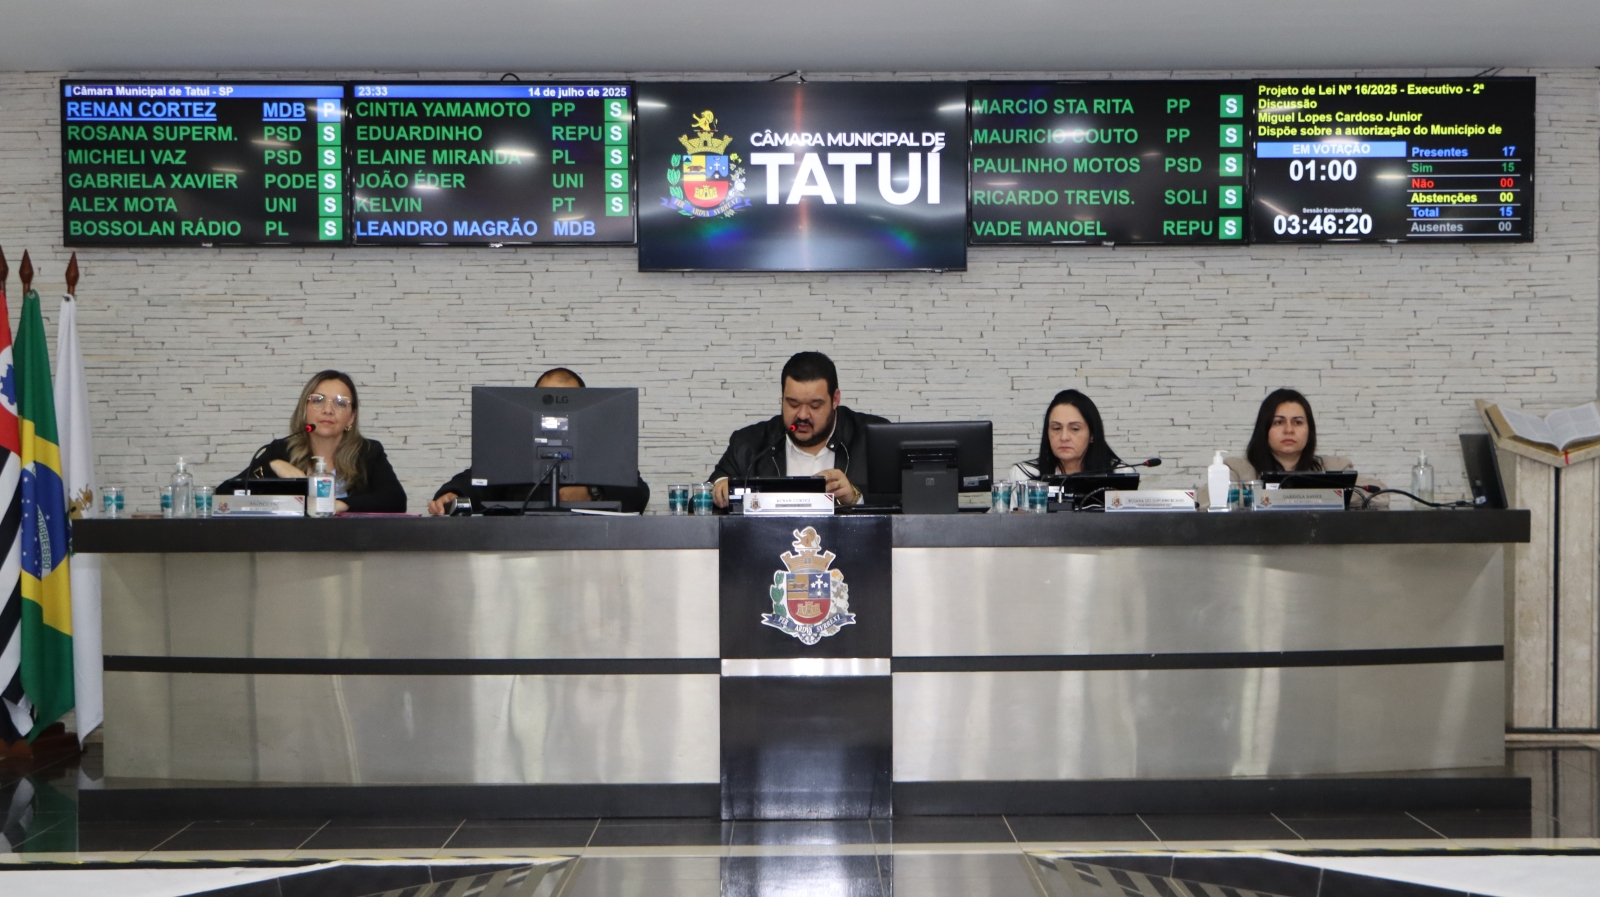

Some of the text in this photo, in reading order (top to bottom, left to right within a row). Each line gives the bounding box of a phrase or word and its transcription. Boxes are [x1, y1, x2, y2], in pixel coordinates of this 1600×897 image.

[73, 86, 113, 96] Câmara
[116, 86, 166, 98] Municipal
[169, 87, 182, 96] de
[219, 87, 234, 96] SP
[358, 87, 388, 96] 23:33
[529, 88, 627, 98] 14 de julho de 2025
[1258, 86, 1299, 98] Projeto
[1301, 86, 1315, 95] de
[1318, 85, 1335, 95] Lei
[1339, 85, 1352, 95] Nº
[1356, 85, 1397, 95] 16/2025
[1408, 84, 1463, 94] Executivo
[1473, 84, 1484, 94] 2ª
[67, 102, 335, 117] RENAN CORTEZ MDB P
[356, 102, 622, 117] CINTIA YAMAMOTO PP S
[974, 98, 1238, 114] MARCIO STA RITA PP S
[1258, 99, 1317, 109] Discussão
[1258, 112, 1422, 125] Miguel Lopes Cardoso Junior
[68, 126, 335, 141] ROSANA SUPERM. PSD S
[357, 126, 622, 141] EDUARDINHO REPU S
[750, 129, 946, 147] CÂMARA MUNICIPAL DE
[974, 128, 1238, 144] MAURICIO COUTO PP S
[1258, 126, 1297, 138] Dispõe
[1300, 126, 1332, 136] sobre
[1345, 125, 1410, 138] autorização
[1413, 125, 1428, 135] do
[1431, 125, 1485, 138] Município
[1488, 125, 1502, 135] de
[1293, 142, 1370, 156] EM VOTAÇÃO
[1412, 147, 1515, 157] Presentes 17
[68, 150, 336, 165] MICHELI VAZ PSD S
[357, 150, 622, 165] ELAINE MIRANDA PL S
[974, 157, 1237, 173] PAULINHO MOTOS PSD S
[750, 145, 945, 205] TATUÍ
[1289, 160, 1357, 181] 01:00
[1412, 163, 1515, 173] Sim 15
[68, 173, 336, 189] GABRIELA XAVIER PODE S
[356, 170, 622, 189] JOÃO ÉDER UNI S
[1411, 178, 1514, 188] Não 00
[69, 197, 336, 212] ALEX MOTA UNI S
[356, 198, 623, 212] KELVIN PT S
[974, 190, 1236, 205] RICARDO TREVIS. SOLI S
[1411, 193, 1513, 205] Abstenções 00
[1411, 208, 1513, 217] Total 15
[70, 217, 337, 236] BOSSOLAN RÁDIO PL S
[356, 217, 595, 236] LEANDRO MAGRÃO MDB
[973, 220, 1236, 236] VADE MANOEL REPU S
[1274, 214, 1373, 235] 03:46:20
[1411, 222, 1512, 232] Ausentes 00
